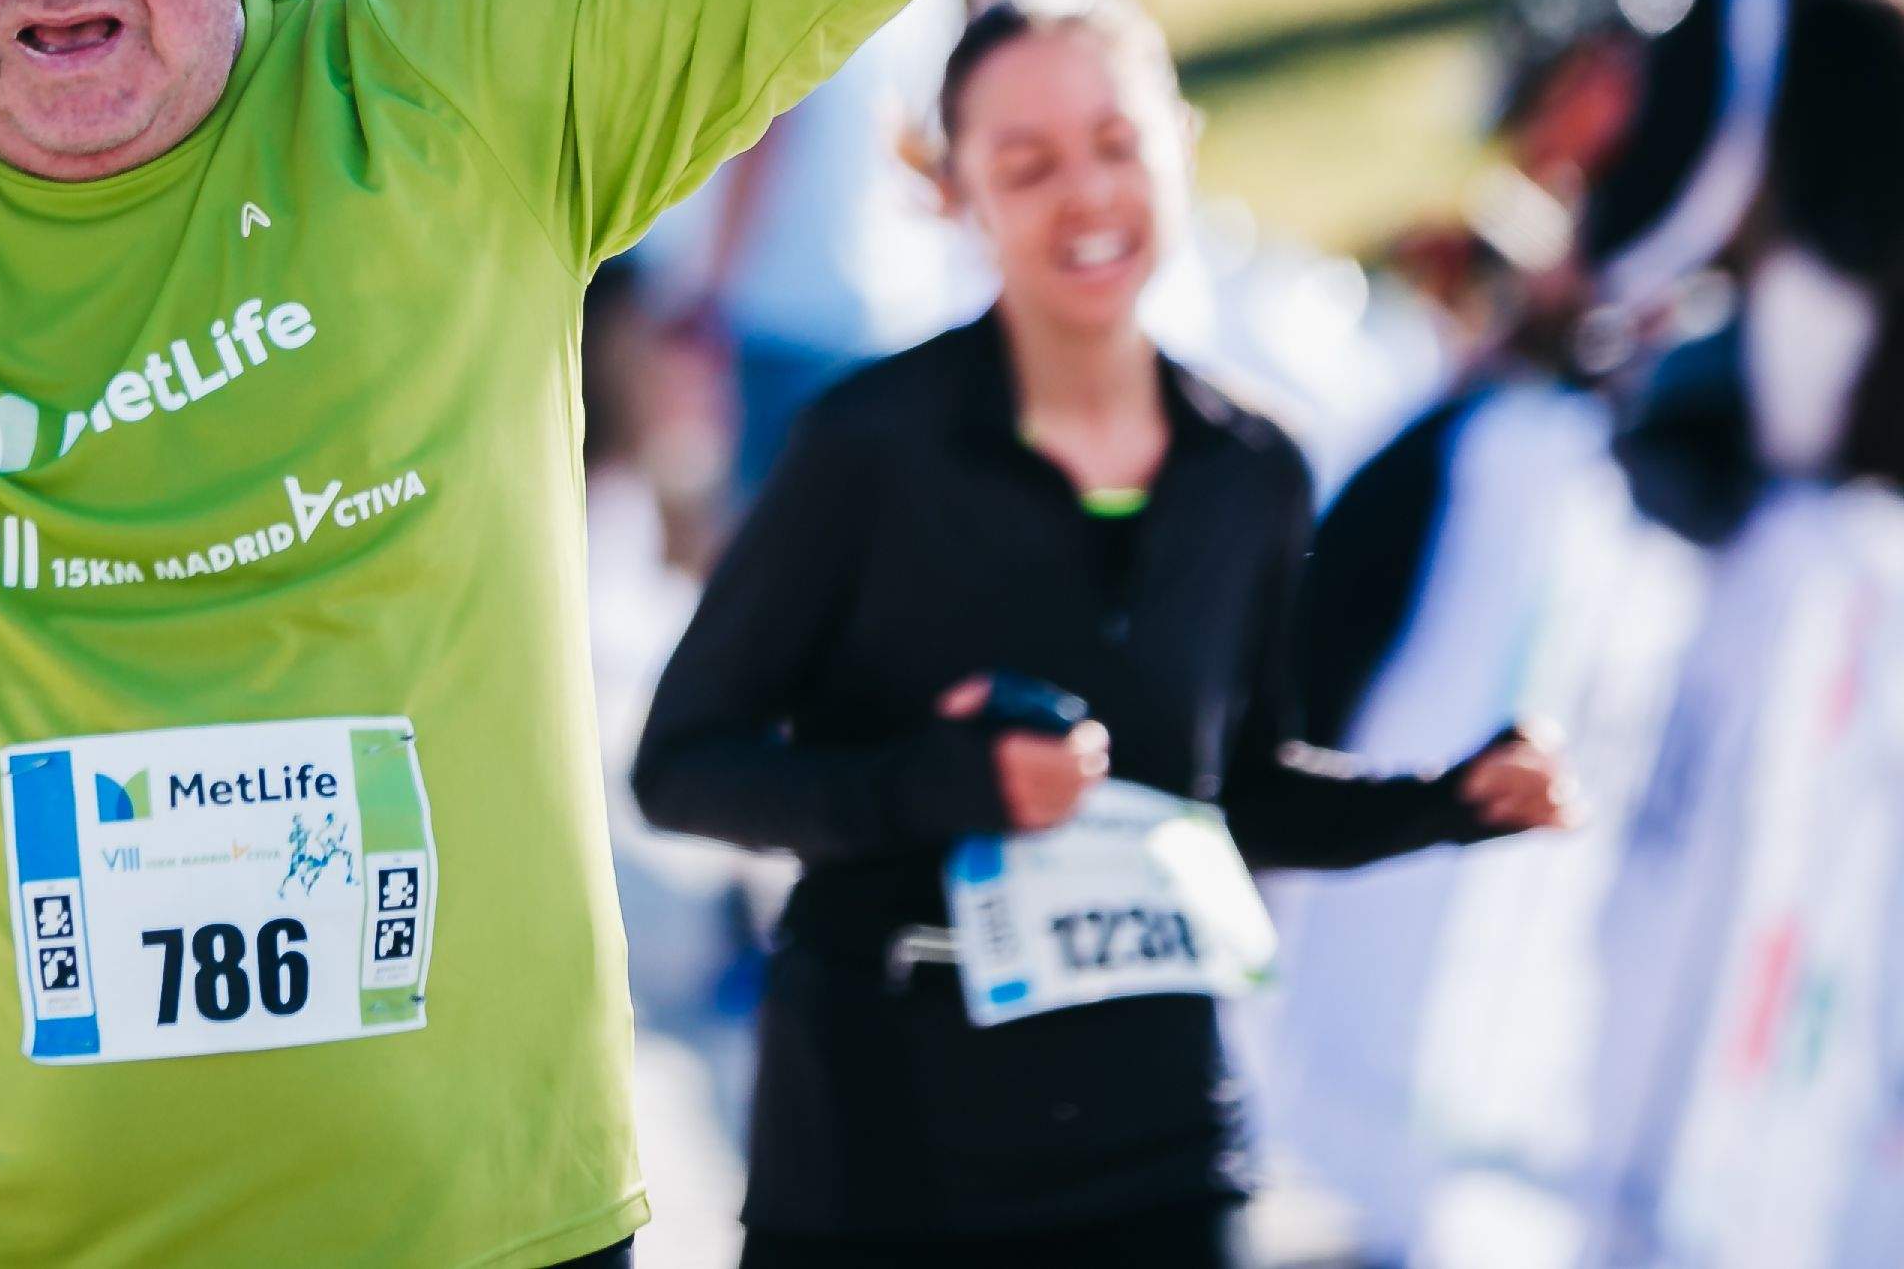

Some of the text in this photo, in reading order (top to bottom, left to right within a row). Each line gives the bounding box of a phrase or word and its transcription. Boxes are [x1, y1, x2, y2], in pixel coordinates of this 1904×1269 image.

[51, 556, 145, 589] 15KM
[153, 522, 295, 581] MADRID
[169, 763, 338, 810] MetLife
[101, 847, 141, 872] VIII
[142, 916, 309, 1028] 786
